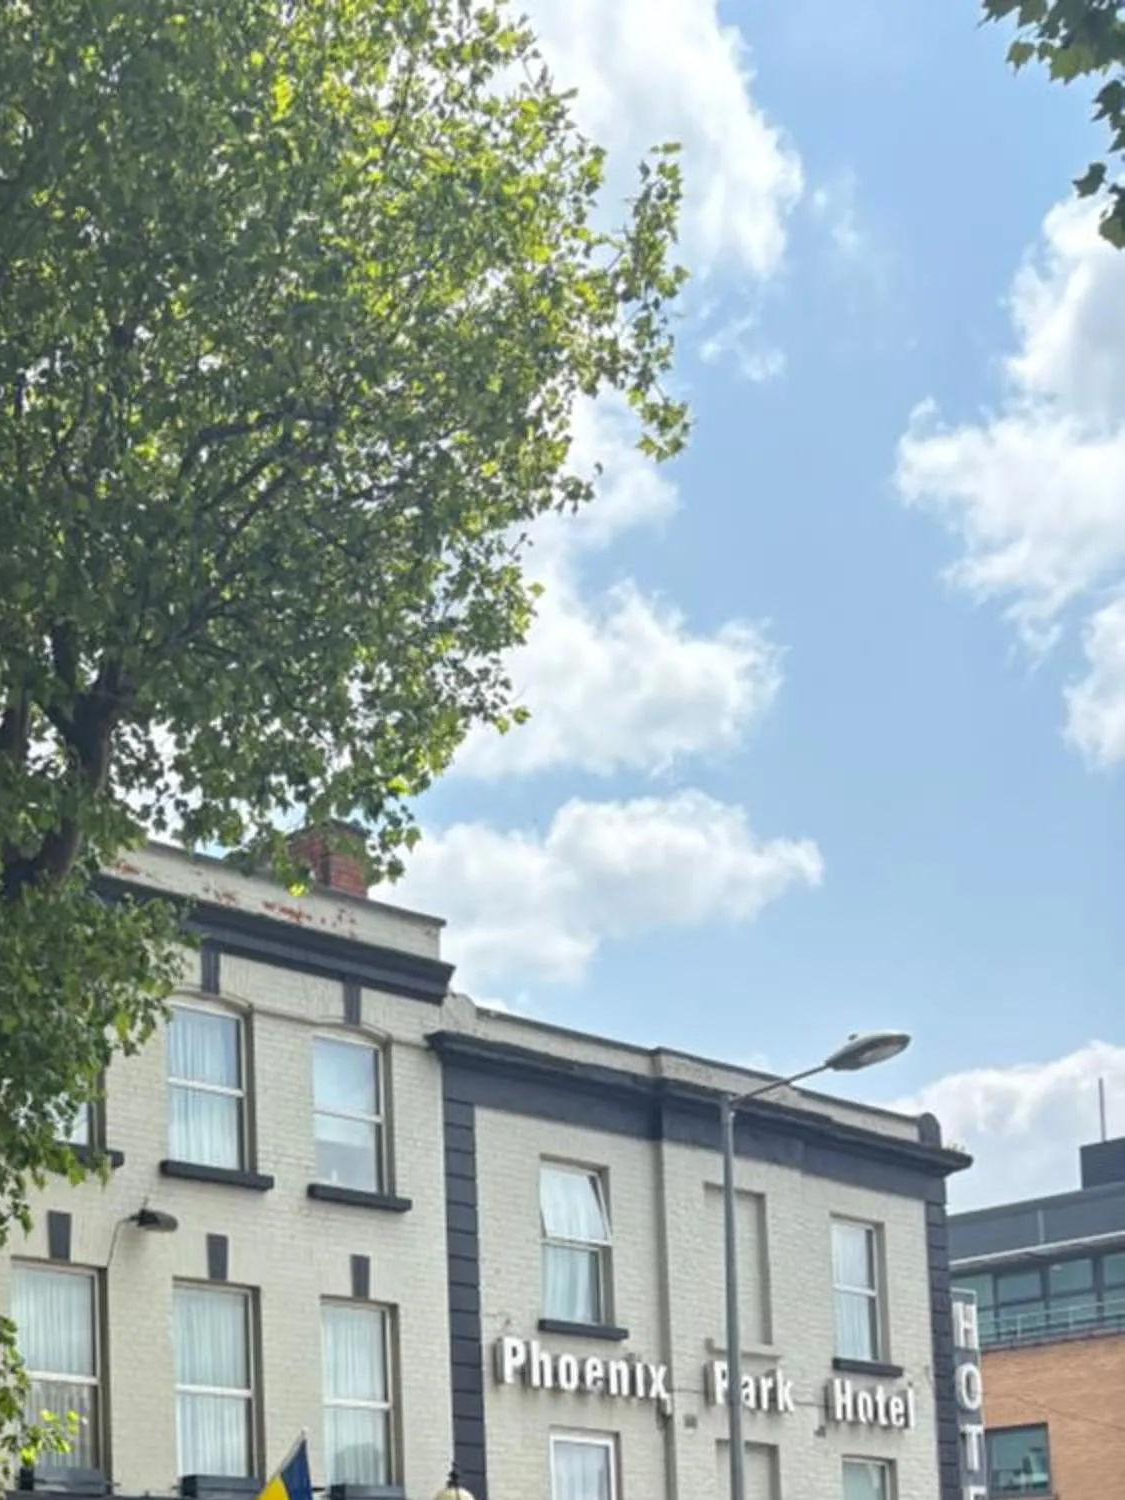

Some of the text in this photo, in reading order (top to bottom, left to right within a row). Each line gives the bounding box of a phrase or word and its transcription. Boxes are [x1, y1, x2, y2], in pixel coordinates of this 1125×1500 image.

[499, 1335, 915, 1428] Phoenix Park Hotel
